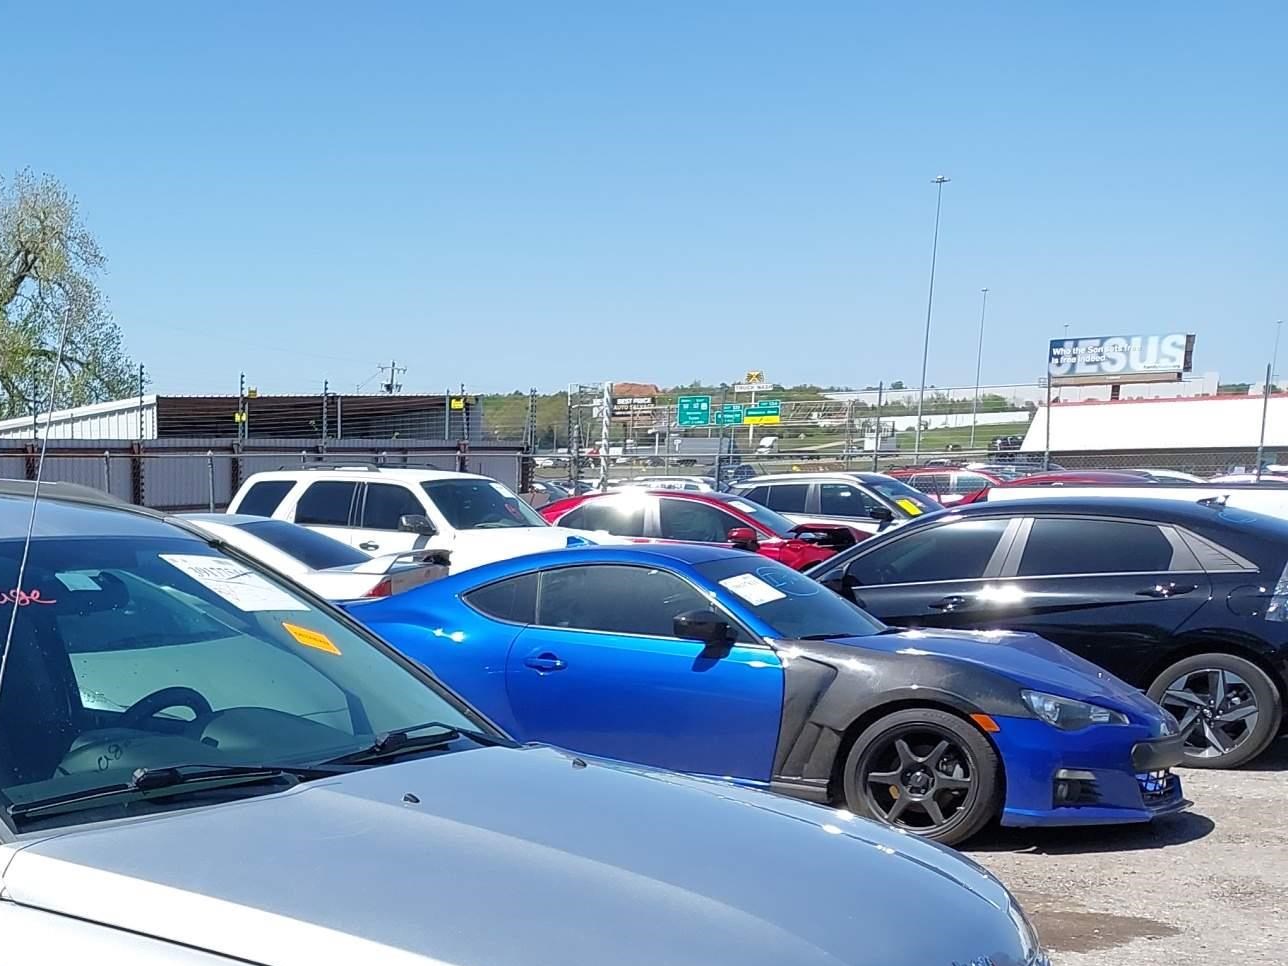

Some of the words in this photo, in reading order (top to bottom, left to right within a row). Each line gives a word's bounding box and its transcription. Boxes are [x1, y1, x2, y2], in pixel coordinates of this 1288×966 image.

[1048, 333, 1187, 375] JESUS
[1052, 346, 1071, 355] Who
[1073, 346, 1086, 354] the
